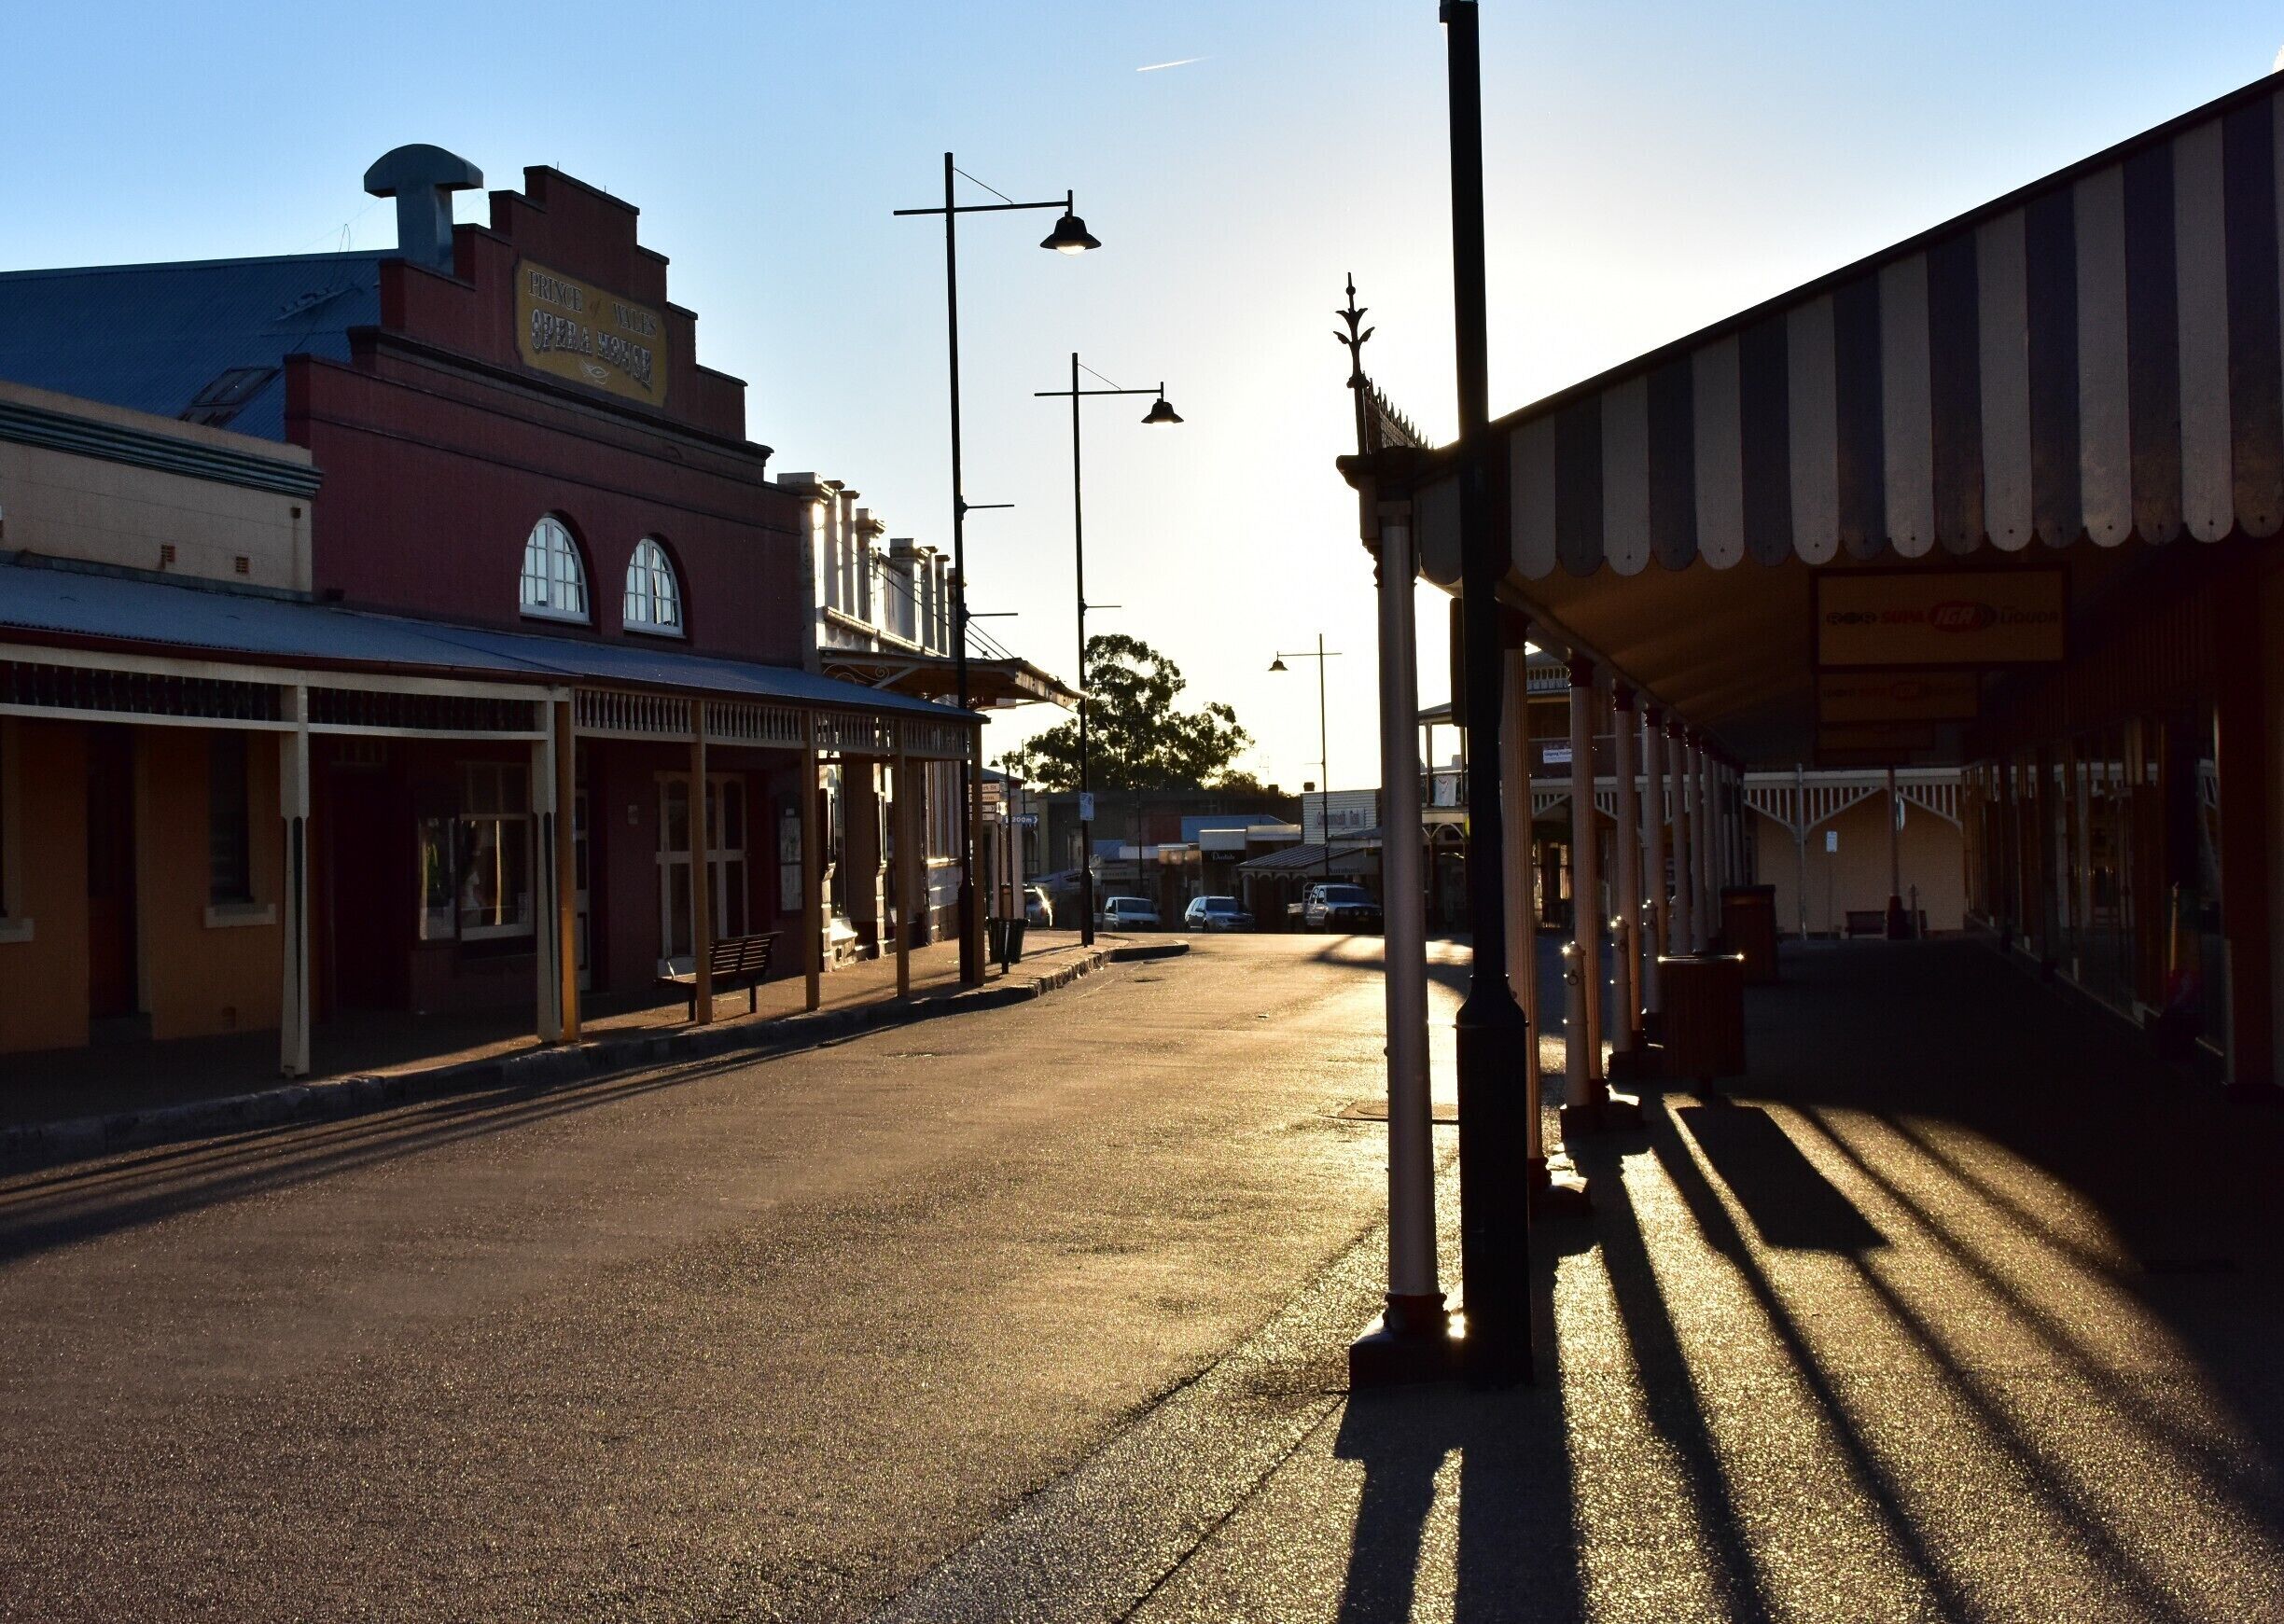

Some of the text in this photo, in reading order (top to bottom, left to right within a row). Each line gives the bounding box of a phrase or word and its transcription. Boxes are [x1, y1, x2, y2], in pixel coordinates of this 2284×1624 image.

[527, 269, 583, 312] PRINCE
[613, 301, 658, 339] WALES
[531, 308, 652, 386] OPERA HOUSE
[1933, 606, 1976, 625] IGA
